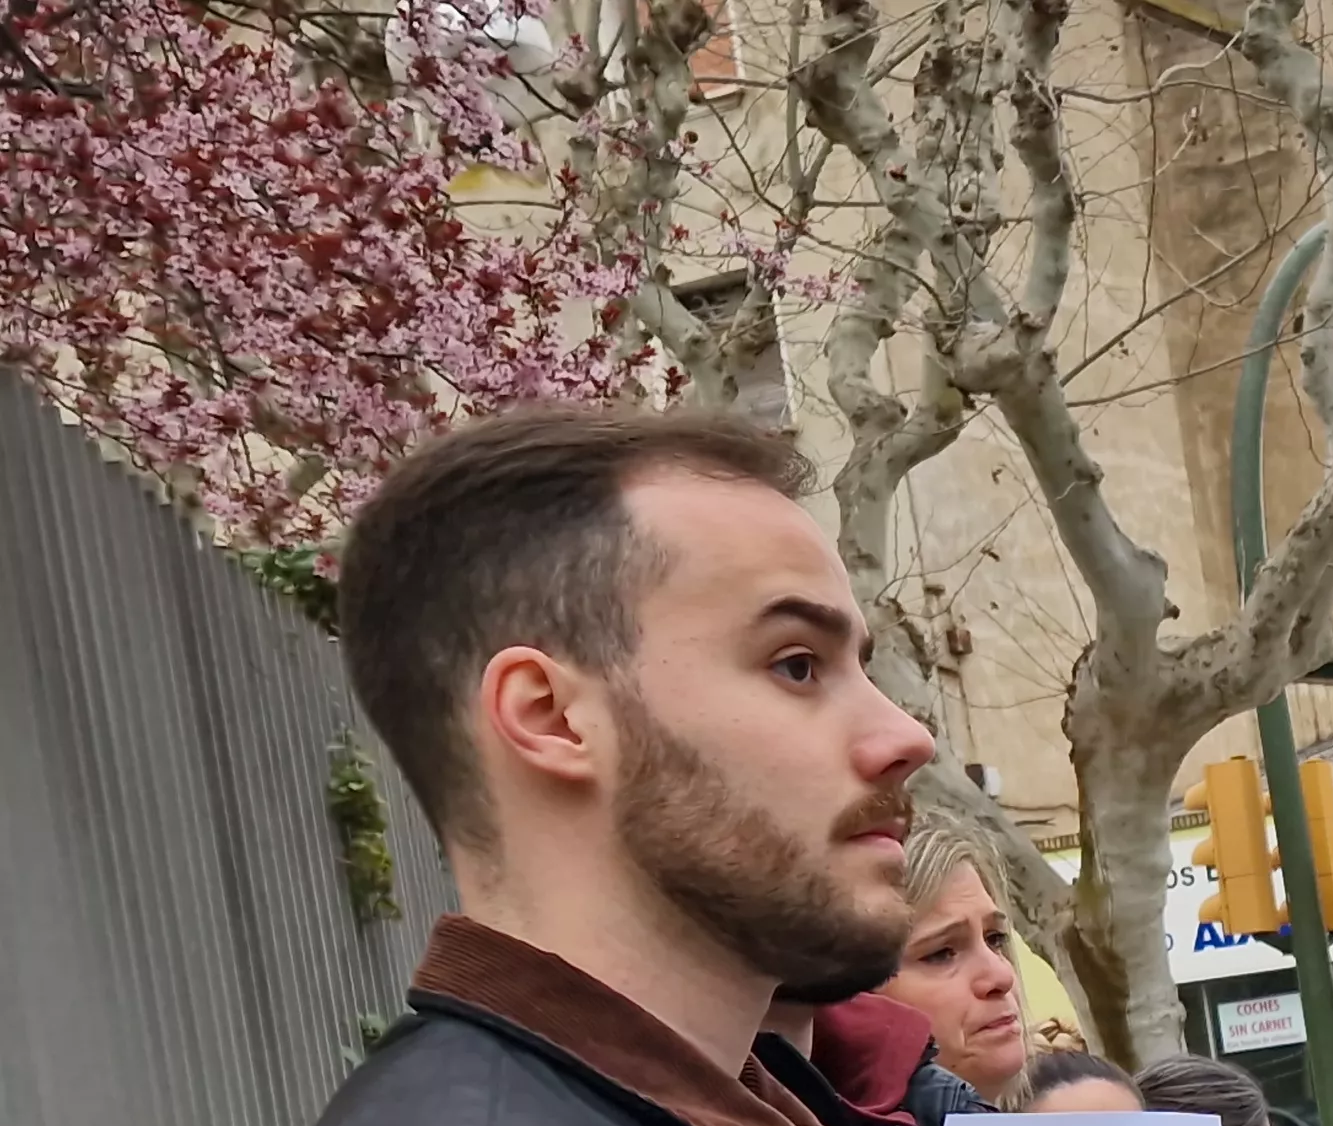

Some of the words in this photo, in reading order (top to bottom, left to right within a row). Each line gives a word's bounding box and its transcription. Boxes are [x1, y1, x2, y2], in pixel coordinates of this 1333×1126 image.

[1236, 999, 1280, 1017] COCHES
[1228, 1022, 1248, 1038] SIN
[1251, 1016, 1293, 1034] CARNET
